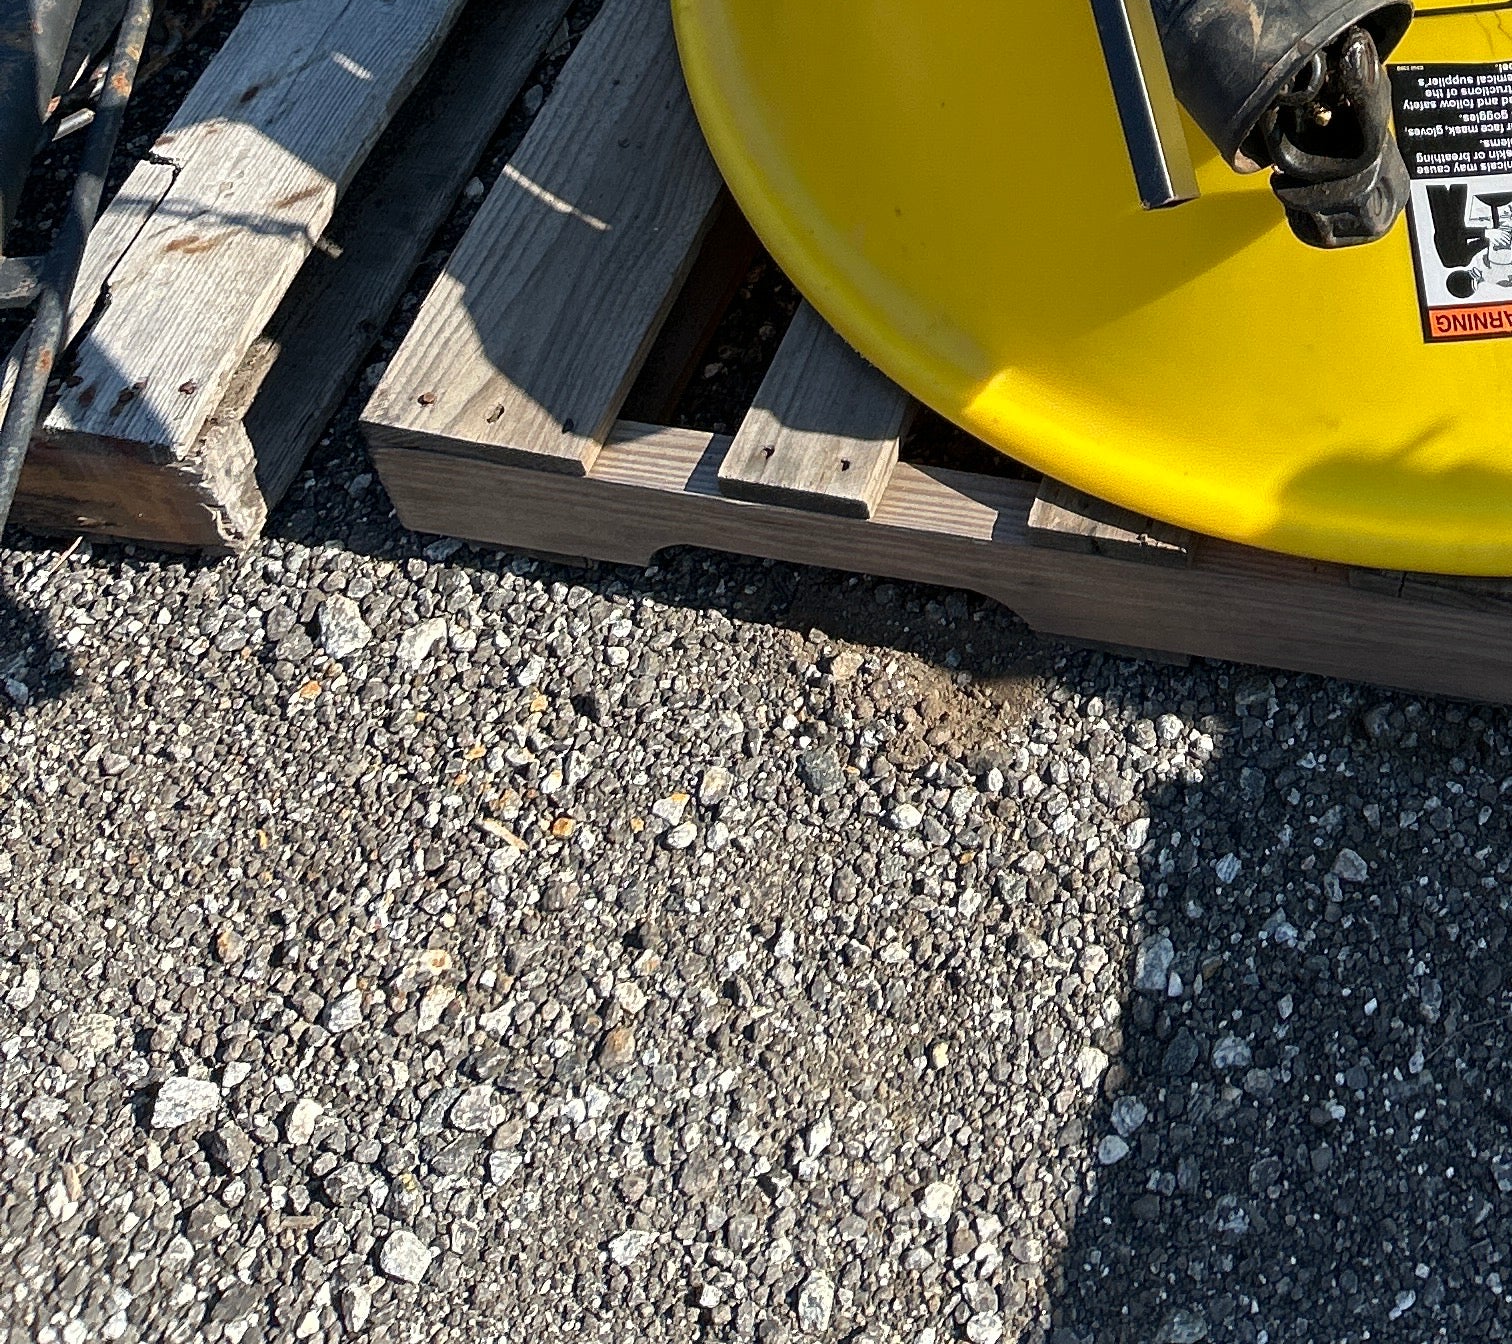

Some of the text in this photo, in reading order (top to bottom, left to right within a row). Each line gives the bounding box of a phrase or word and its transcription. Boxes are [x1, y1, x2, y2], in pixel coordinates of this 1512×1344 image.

[1418, 75, 1473, 88] supplier's
[1425, 89, 1443, 98] the
[1446, 88, 1457, 98] of
[1404, 100, 1437, 111] safety
[1440, 99, 1474, 109] follow
[1477, 98, 1498, 108] and
[1459, 110, 1508, 123] goggles.
[1405, 125, 1443, 137] gloves,
[1445, 125, 1478, 136] mask,
[1481, 124, 1504, 133] face
[1416, 152, 1470, 164] breathing
[1474, 152, 1485, 160] or
[1489, 149, 1512, 160] skin
[1417, 165, 1450, 174] cause
[1454, 162, 1477, 173] may
